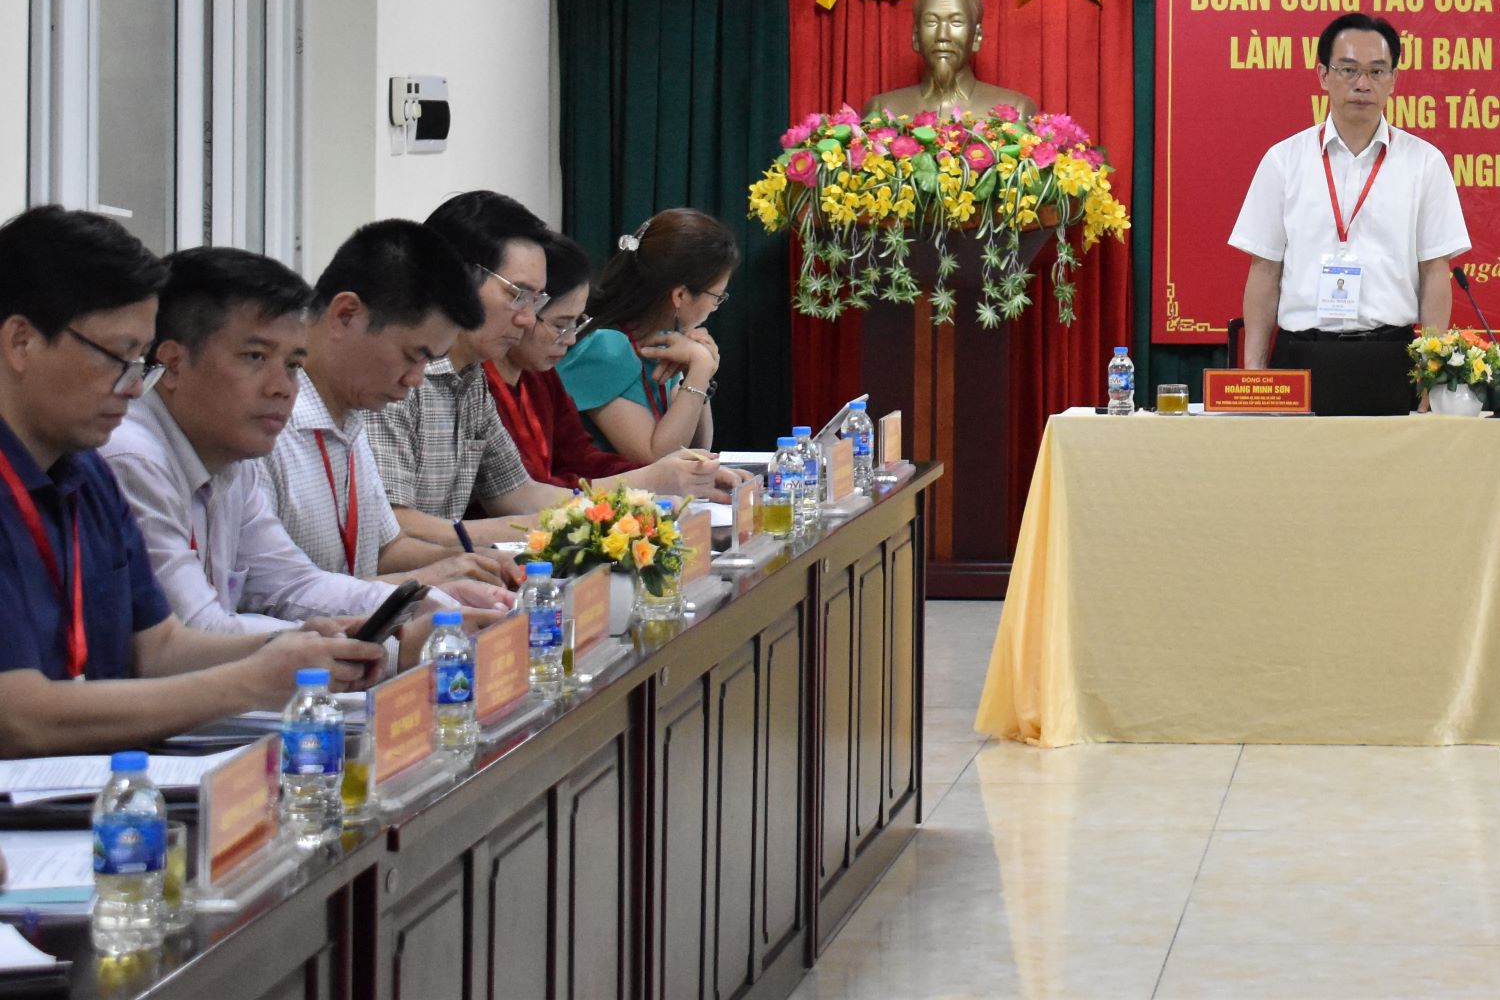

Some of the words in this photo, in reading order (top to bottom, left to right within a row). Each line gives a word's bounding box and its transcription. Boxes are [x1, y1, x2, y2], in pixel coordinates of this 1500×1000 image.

[1230, 29, 1293, 70] LÀM
[1432, 37, 1493, 71] BAN
[1445, 88, 1500, 130] TÁC
[1224, 383, 1251, 394] HOÀNG
[1252, 385, 1273, 394] MINH
[1274, 384, 1291, 394] SƠN
